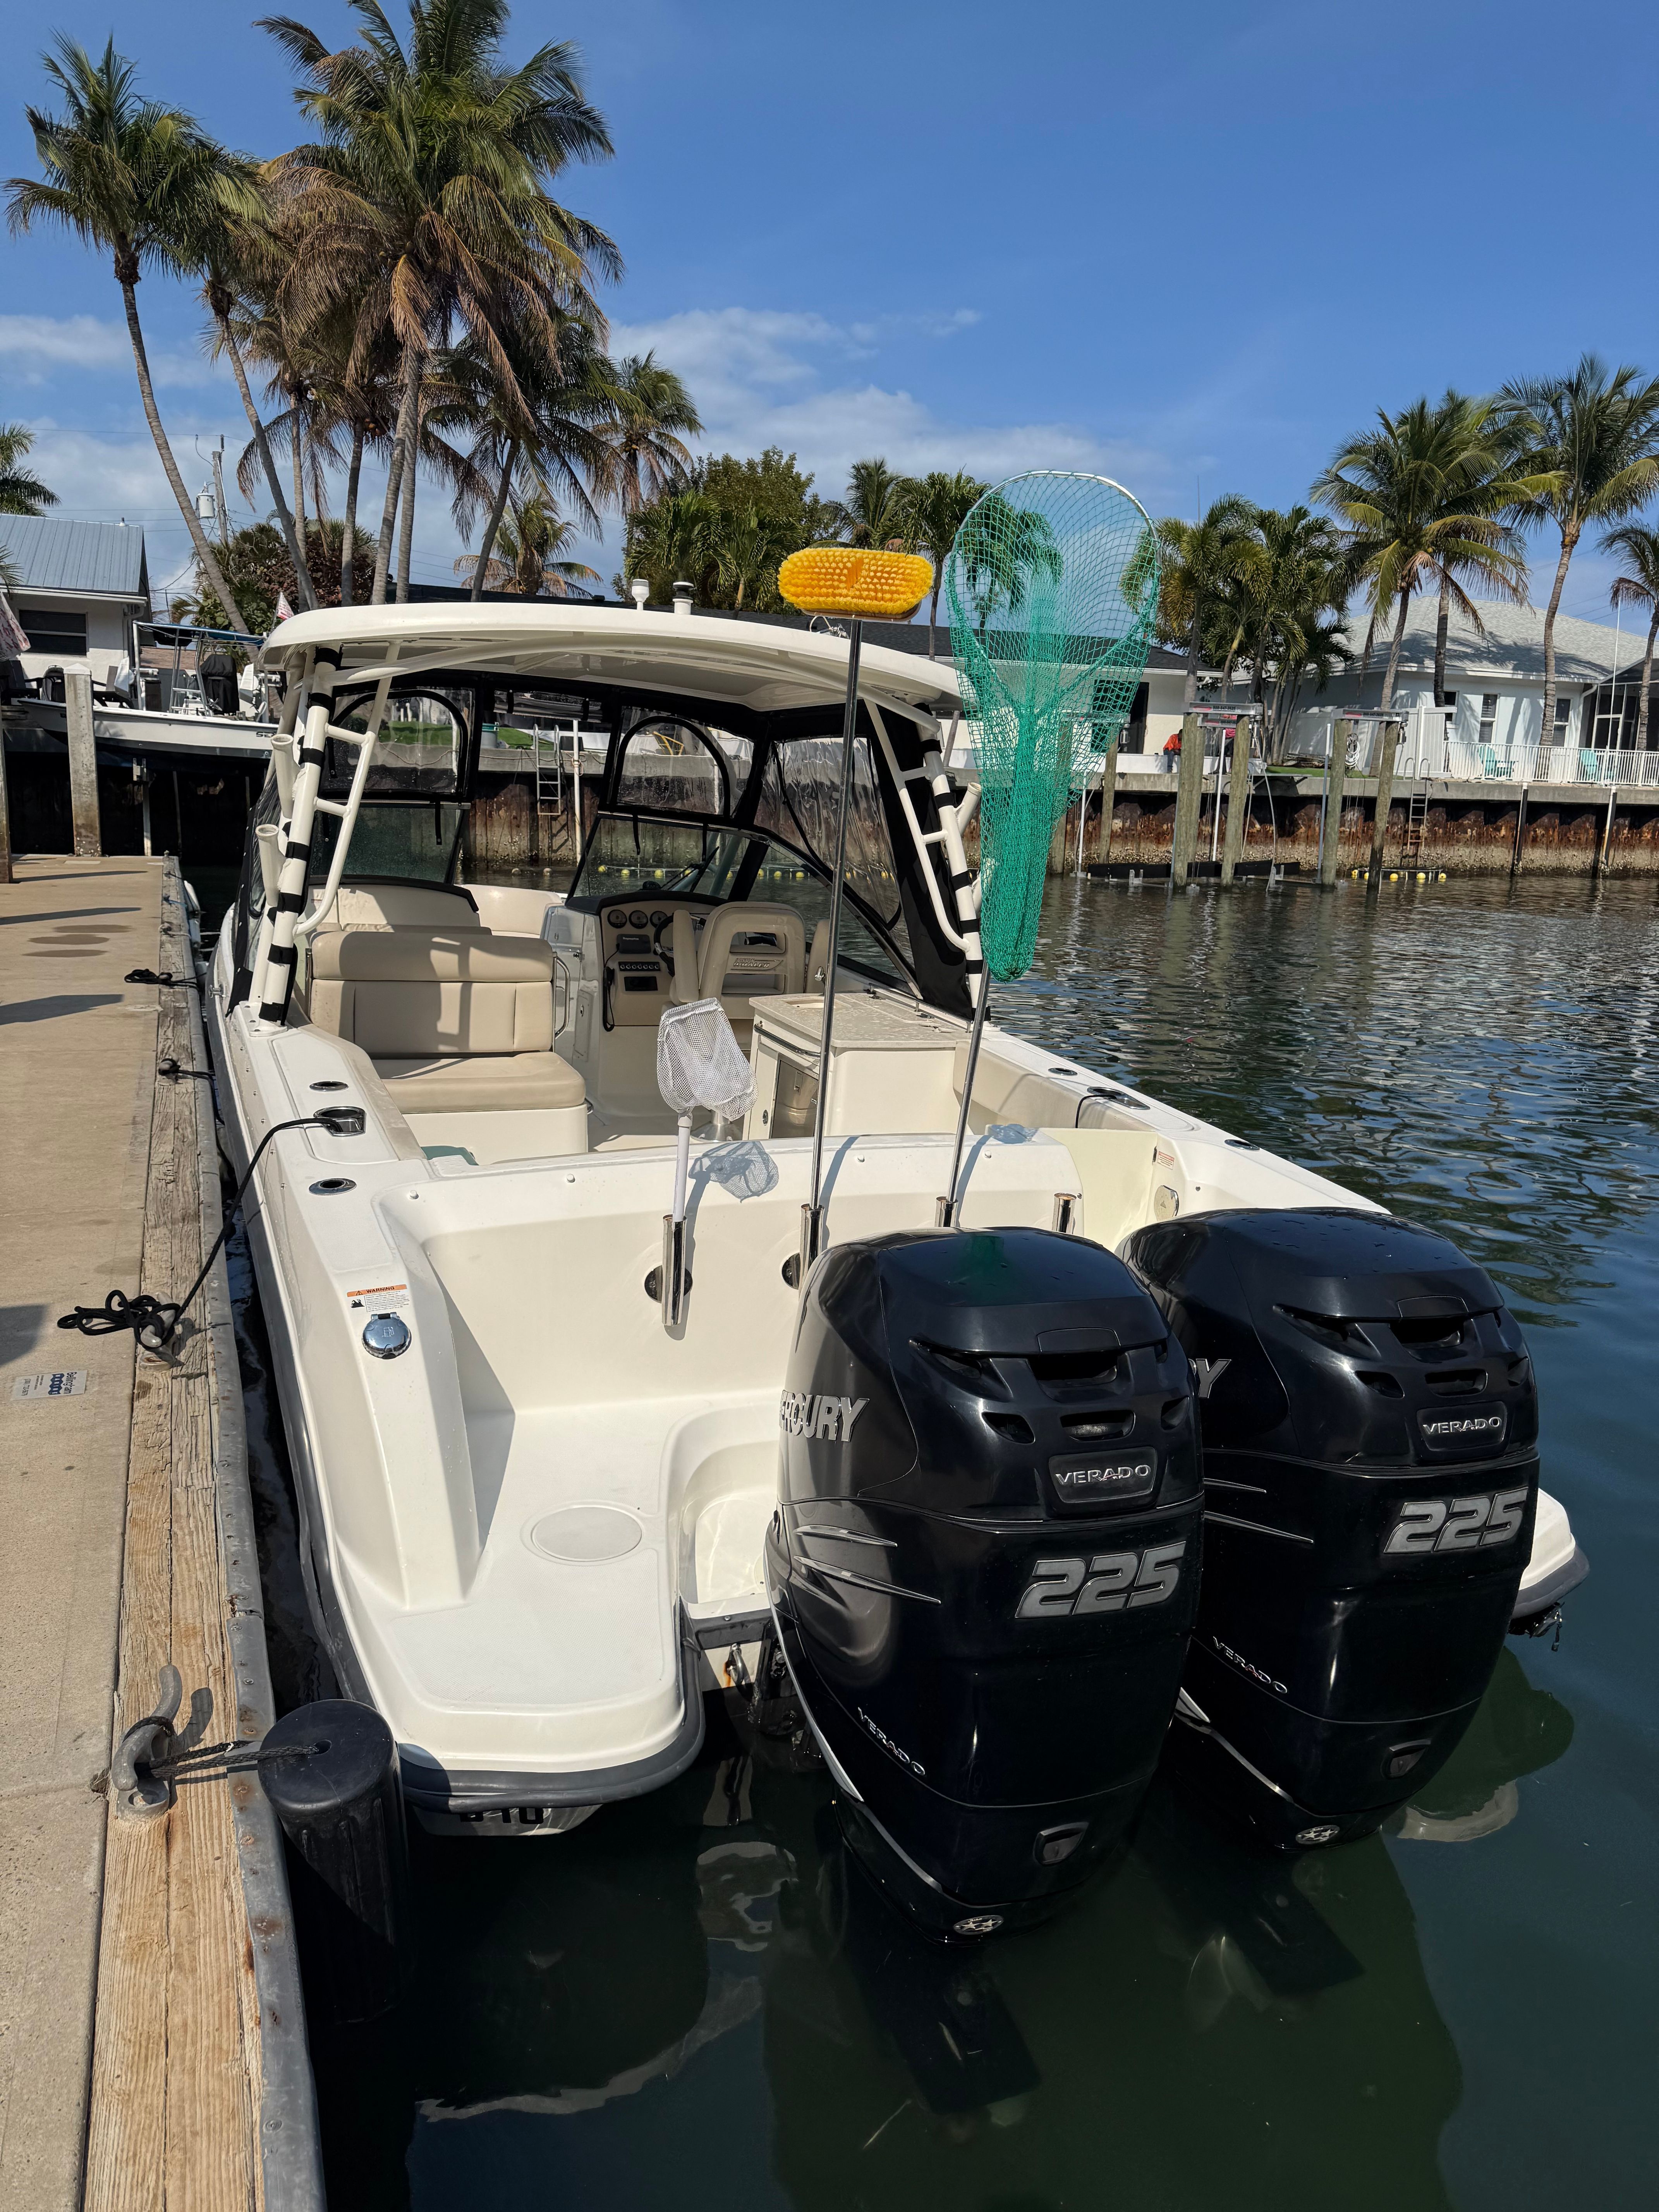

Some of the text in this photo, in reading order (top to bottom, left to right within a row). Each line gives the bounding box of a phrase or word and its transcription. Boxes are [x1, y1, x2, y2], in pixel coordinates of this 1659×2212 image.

[63, 1372, 77, 1394] Bellingham
[779, 1389, 870, 1442] ERCURY
[1423, 1417, 1502, 1434] VERADO
[1055, 1465, 1151, 1485] VERADO
[1383, 1486, 1529, 1554] 225
[1015, 1541, 1187, 1618] 225
[1213, 1636, 1288, 1694] VERADO
[858, 1707, 925, 1776] VERADO
